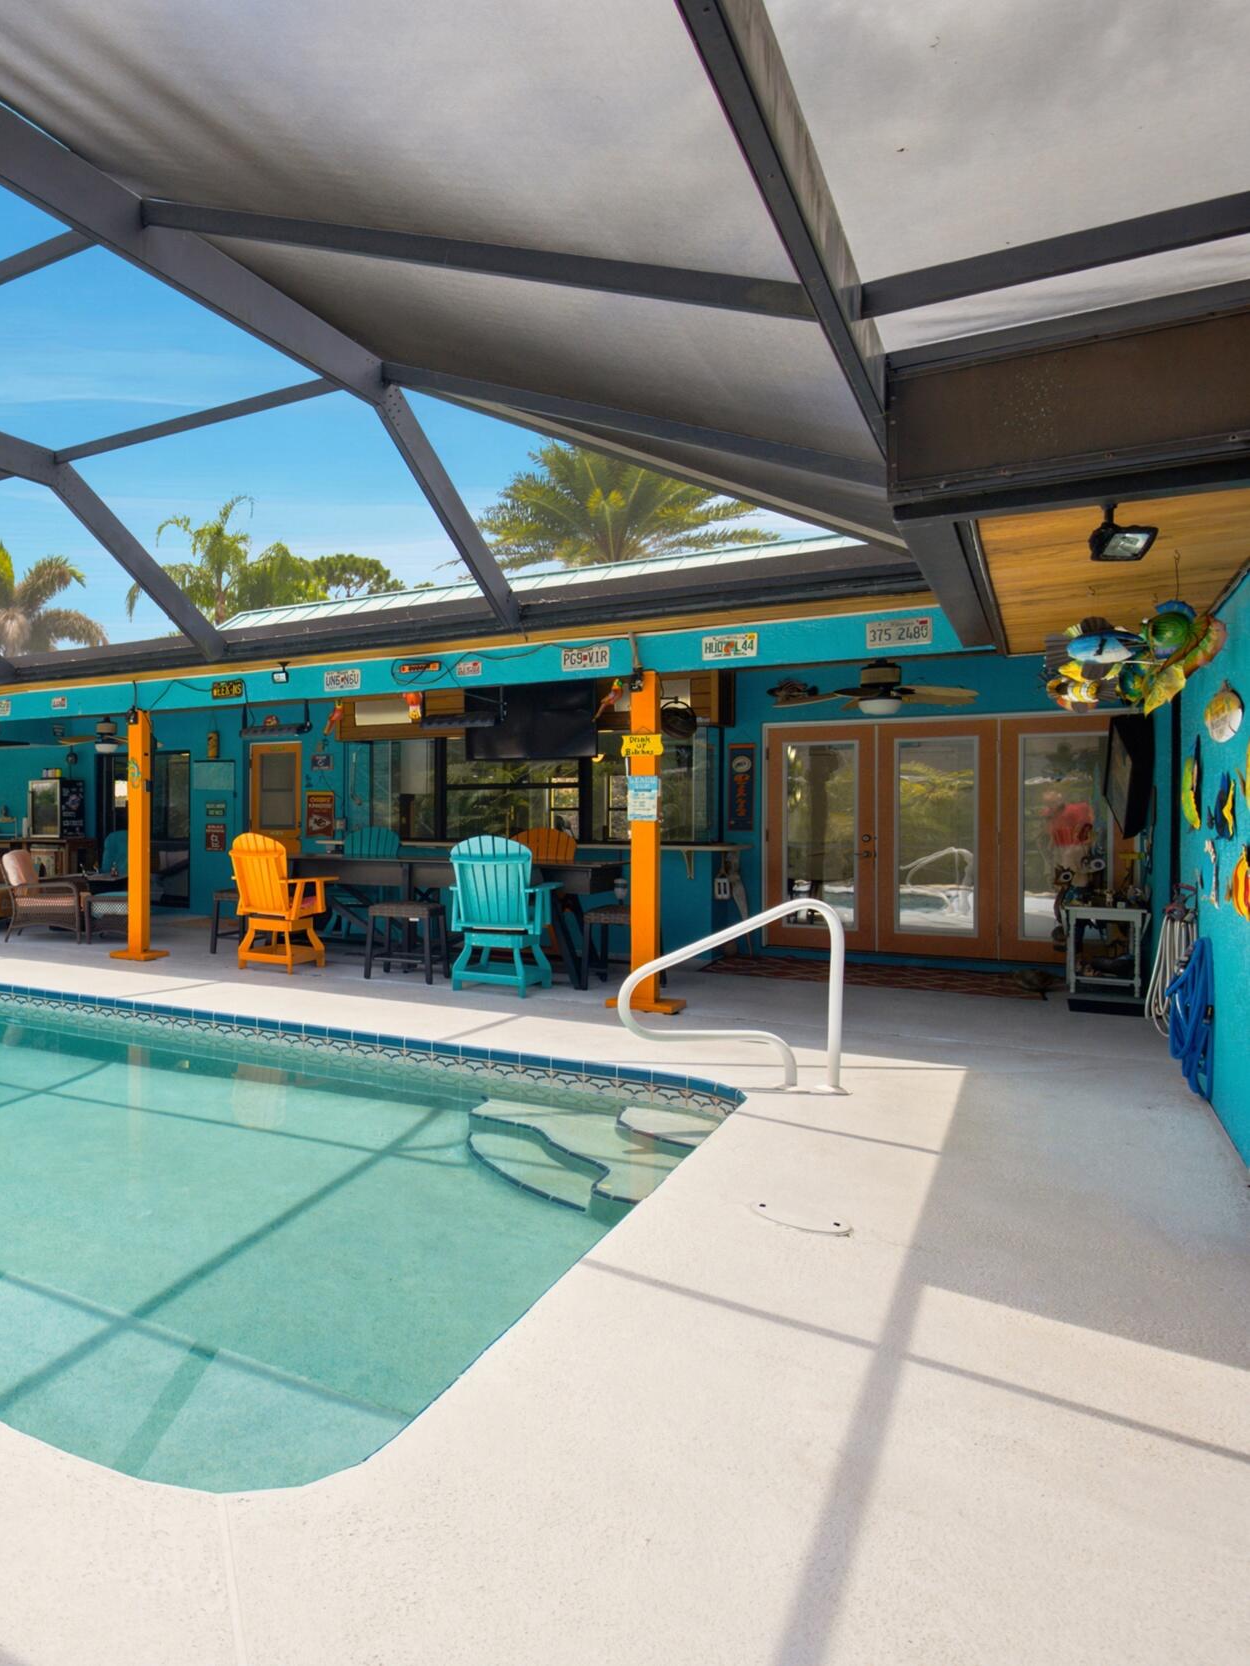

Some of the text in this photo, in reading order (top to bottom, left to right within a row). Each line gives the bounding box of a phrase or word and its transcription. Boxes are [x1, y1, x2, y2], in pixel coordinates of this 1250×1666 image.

[869, 628, 892, 642] 375
[734, 639, 754, 652] L44
[563, 652, 583, 666] PG9
